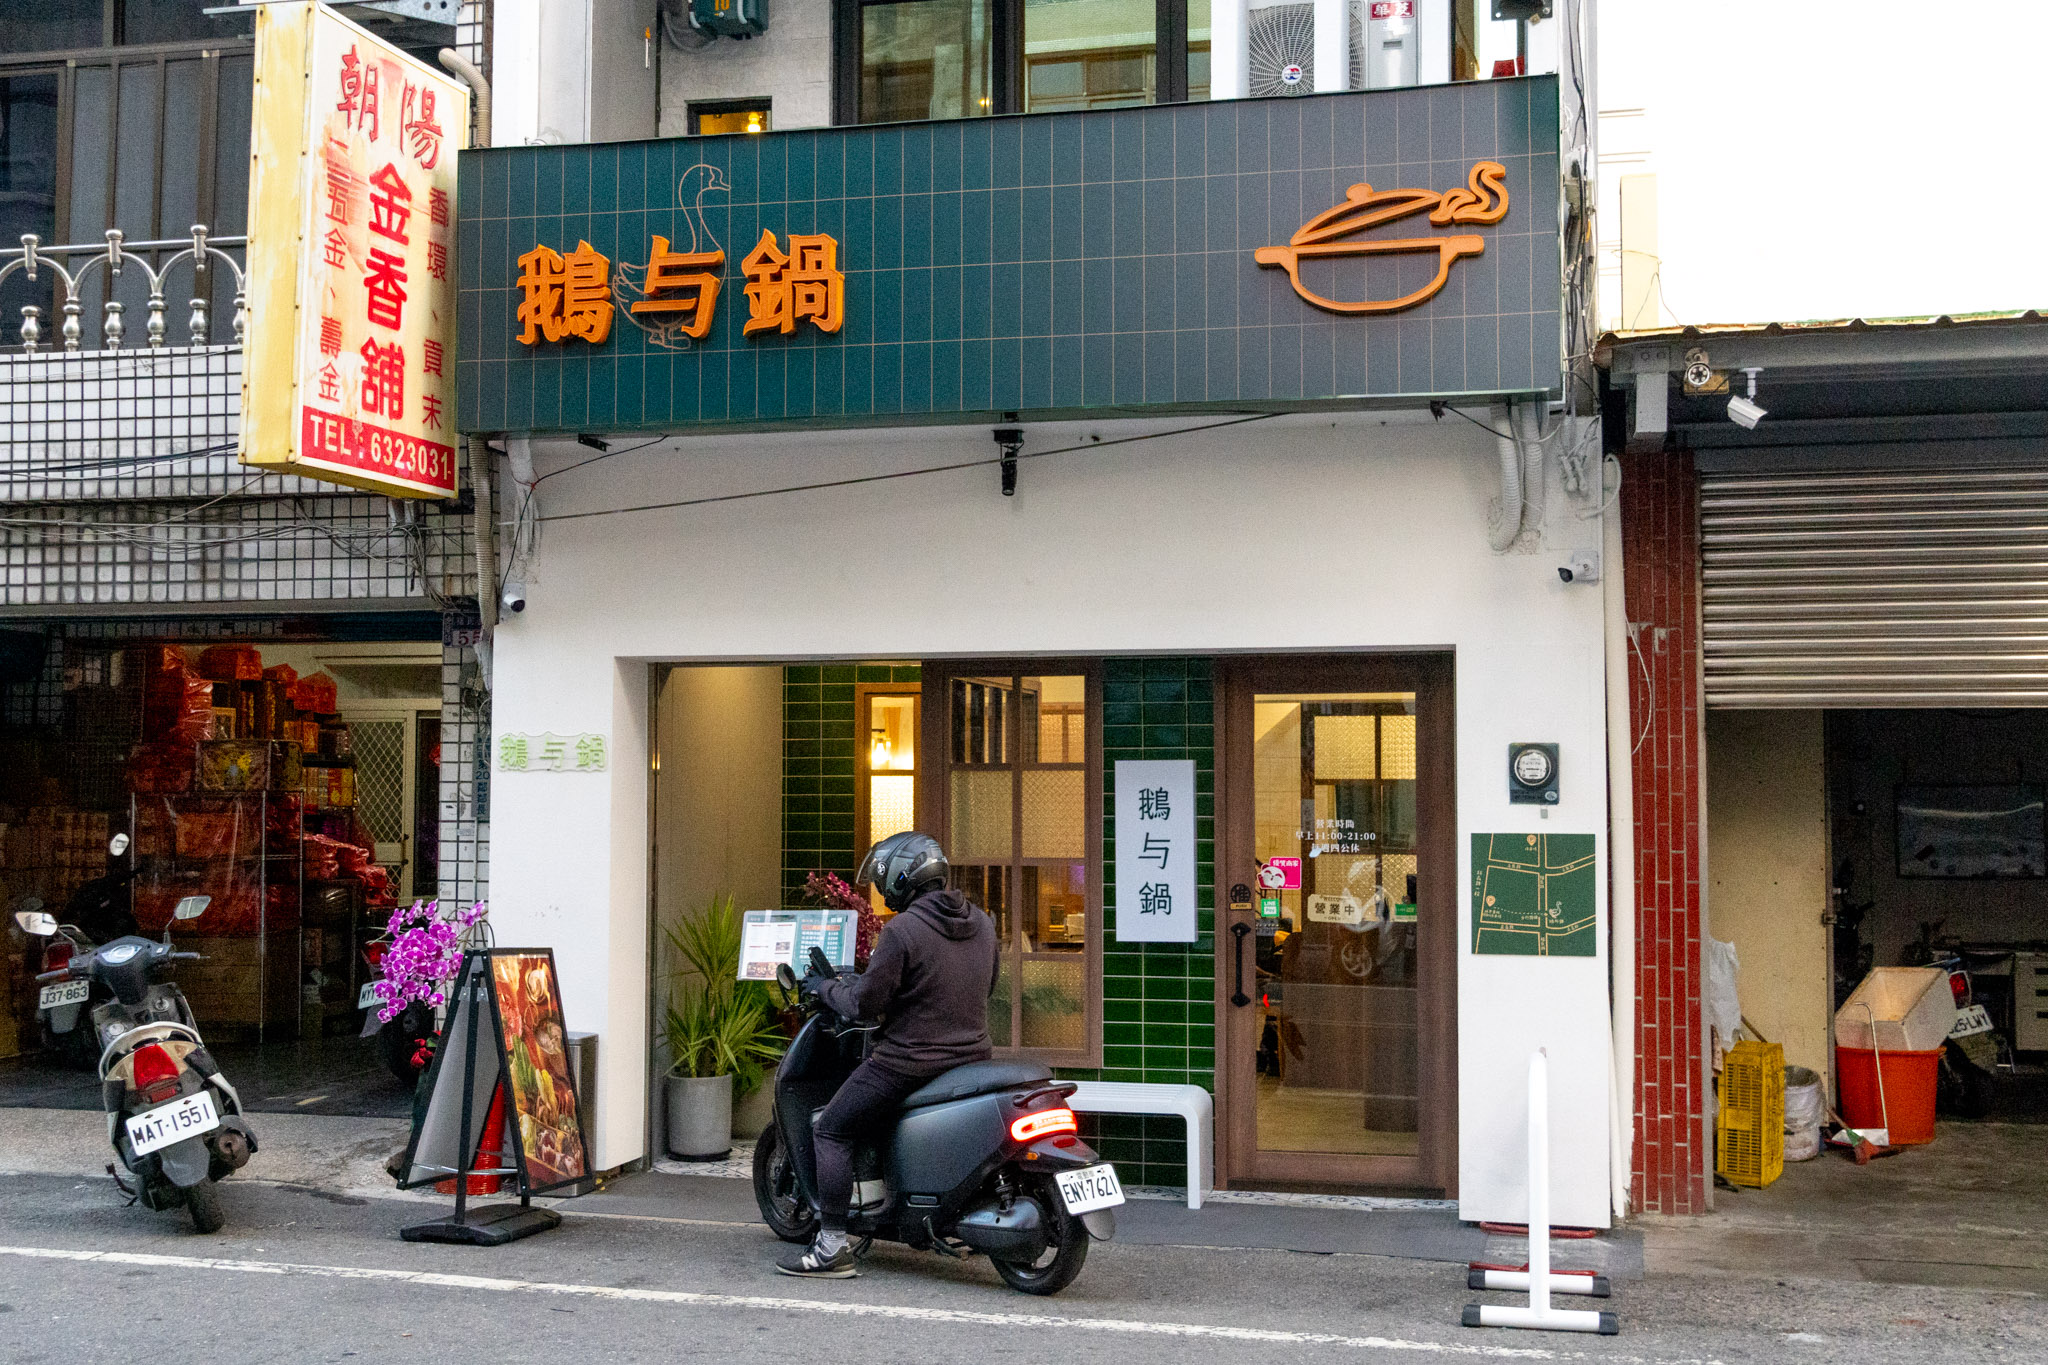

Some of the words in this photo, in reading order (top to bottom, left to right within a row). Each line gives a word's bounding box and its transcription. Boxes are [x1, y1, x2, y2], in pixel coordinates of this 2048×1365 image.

[337, 44, 444, 169] 朝陽
[516, 228, 846, 346] 鵝与鍋
[1138, 787, 1172, 916] 鵝与鍋
[1316, 819, 1355, 829] 營業時間
[1314, 902, 1355, 916] 營業中
[1949, 1012, 1989, 1034] 25-LWY
